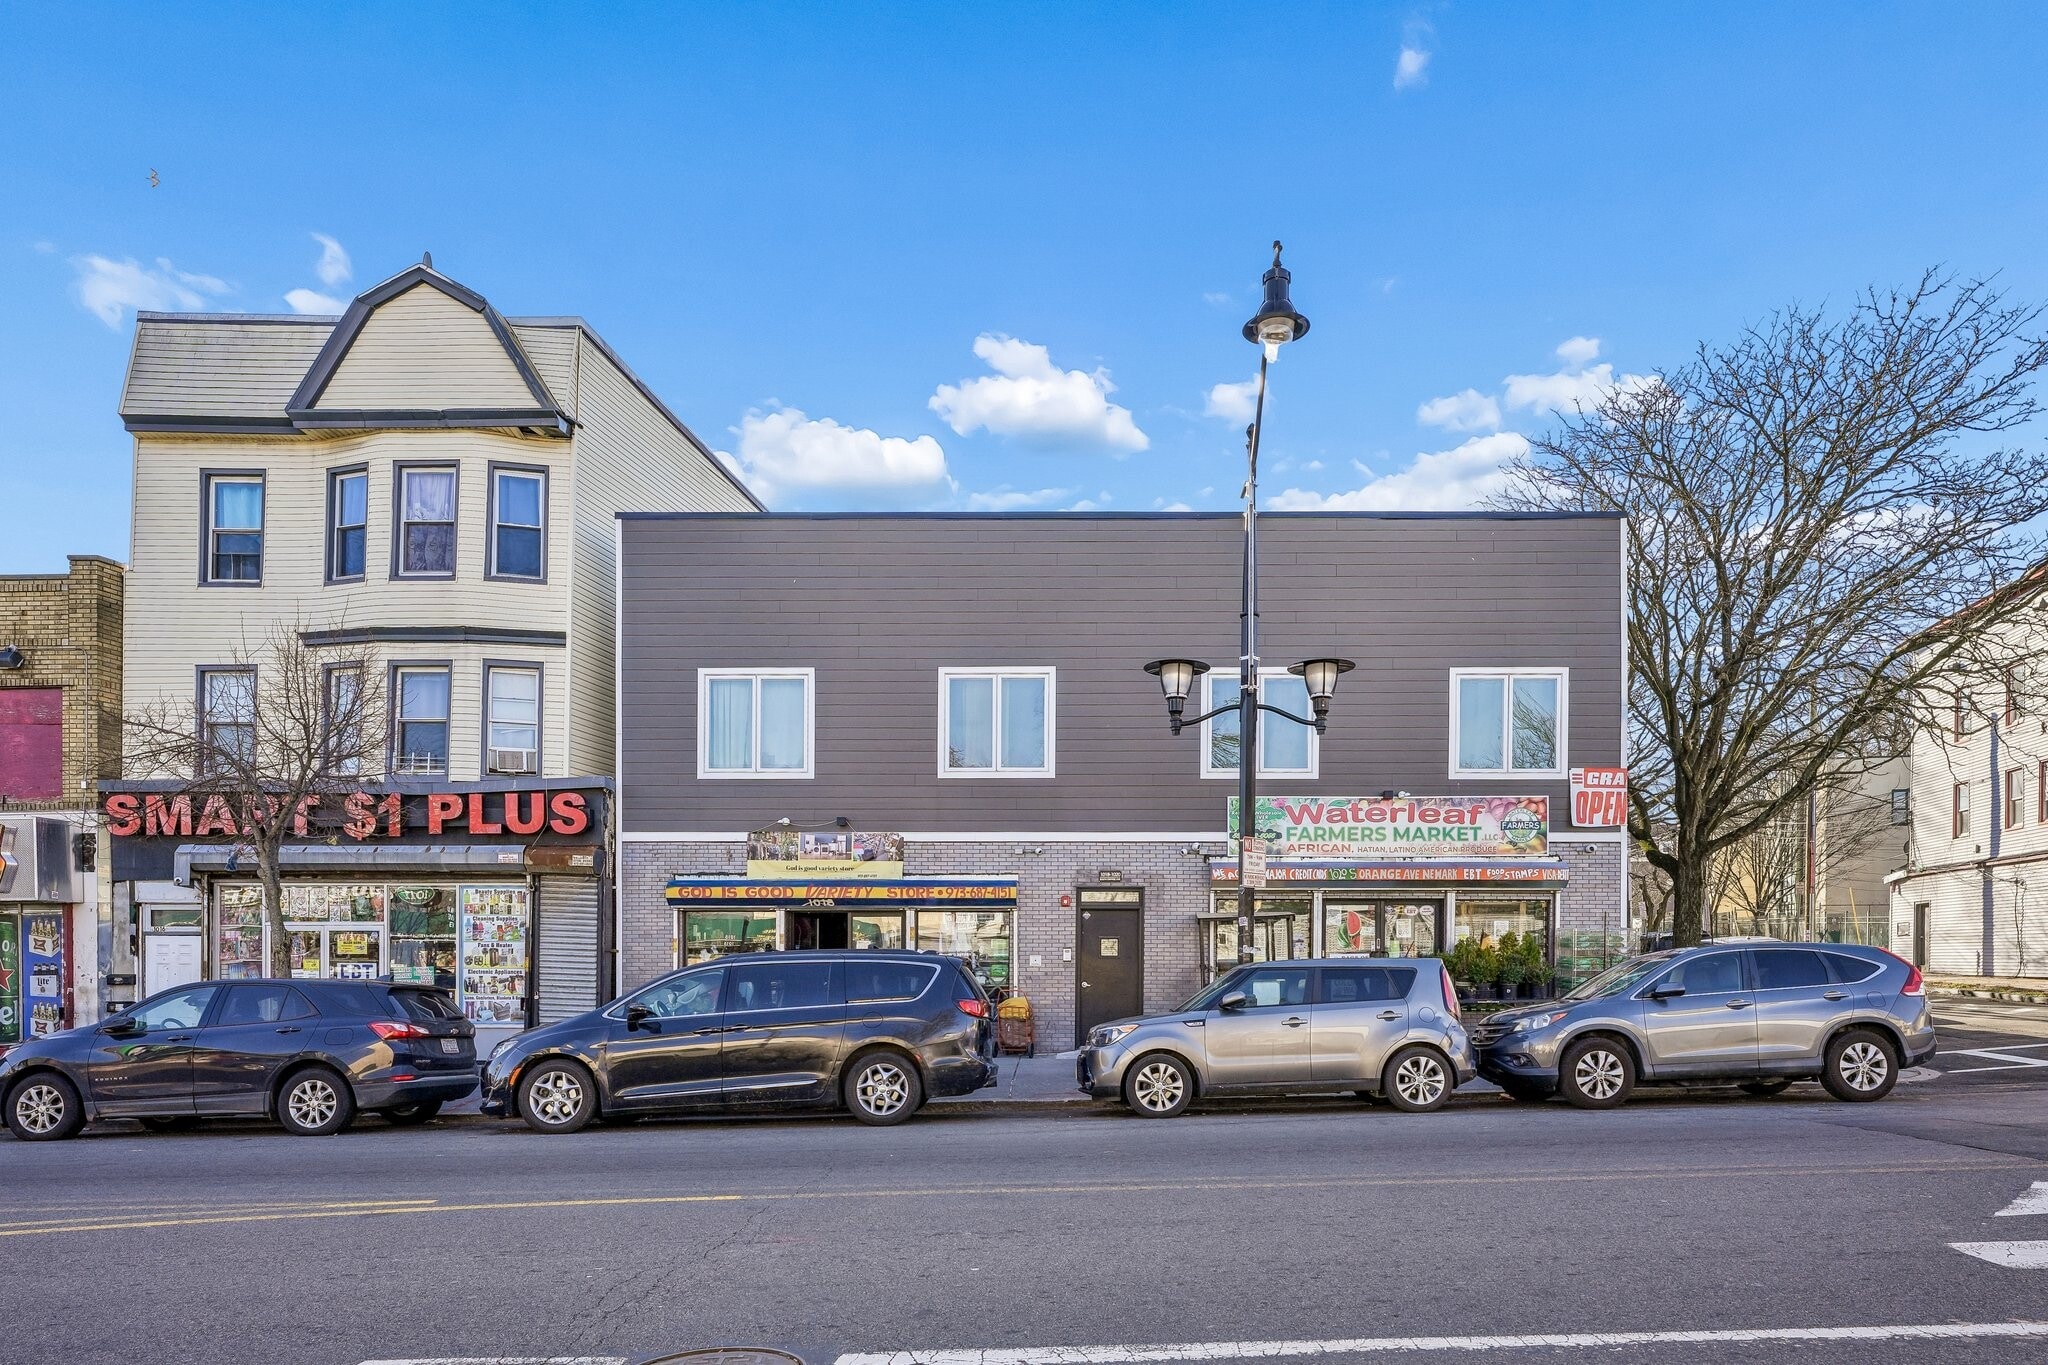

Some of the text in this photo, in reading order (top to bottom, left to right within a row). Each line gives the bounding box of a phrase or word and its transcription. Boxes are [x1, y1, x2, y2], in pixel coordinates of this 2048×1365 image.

[1587, 772, 1625, 785] GRA
[428, 792, 588, 834] PLUS
[1284, 803, 1486, 825] Waterleaf
[1576, 791, 1627, 824] OPEN
[1501, 821, 1540, 830] FARMERS
[1286, 826, 1387, 842] FARMERS
[1393, 826, 1482, 842] MARKET
[1213, 869, 1225, 878] WE
[1358, 869, 1400, 880] ORANGE
[1403, 869, 1420, 880] AVE
[1422, 869, 1458, 880] NEWARK
[1463, 869, 1481, 880] EBT
[1504, 868, 1539, 880] STAMPS
[678, 884, 1012, 898] GOD IS GOOD VARIETY STORE 973-687-4151
[37, 977, 50, 986] Lite
